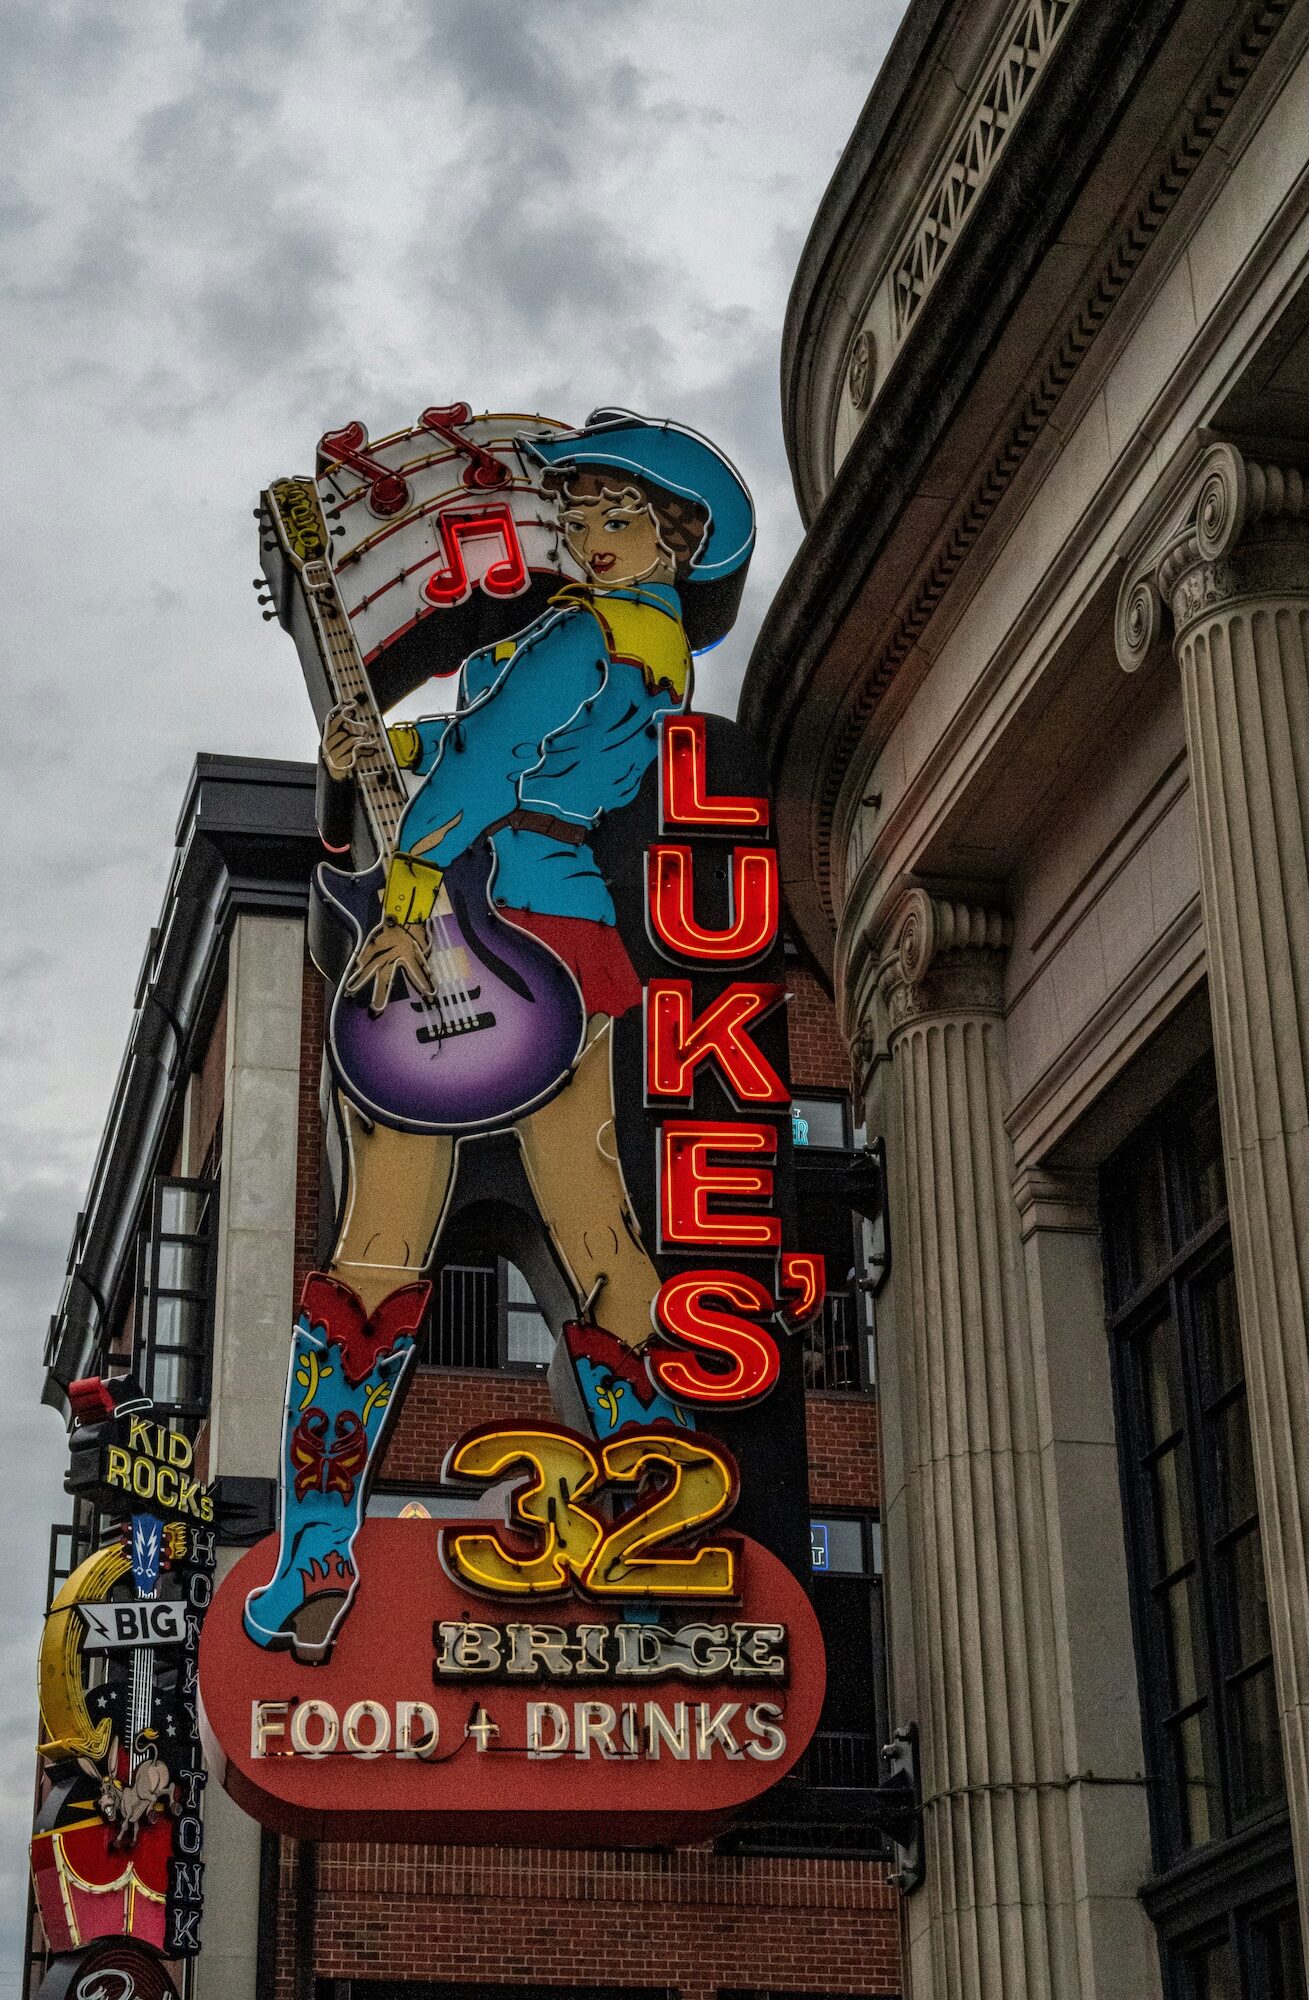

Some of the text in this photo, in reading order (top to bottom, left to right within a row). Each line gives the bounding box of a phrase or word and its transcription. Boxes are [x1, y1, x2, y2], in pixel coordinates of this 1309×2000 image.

[128, 1413, 194, 1469] KID
[440, 1419, 743, 1602] 32
[114, 1604, 178, 1641] BIG
[436, 1621, 786, 1676] BRIDGE
[251, 1700, 440, 1760] FOOD
[526, 1701, 787, 1762] DRINKS
